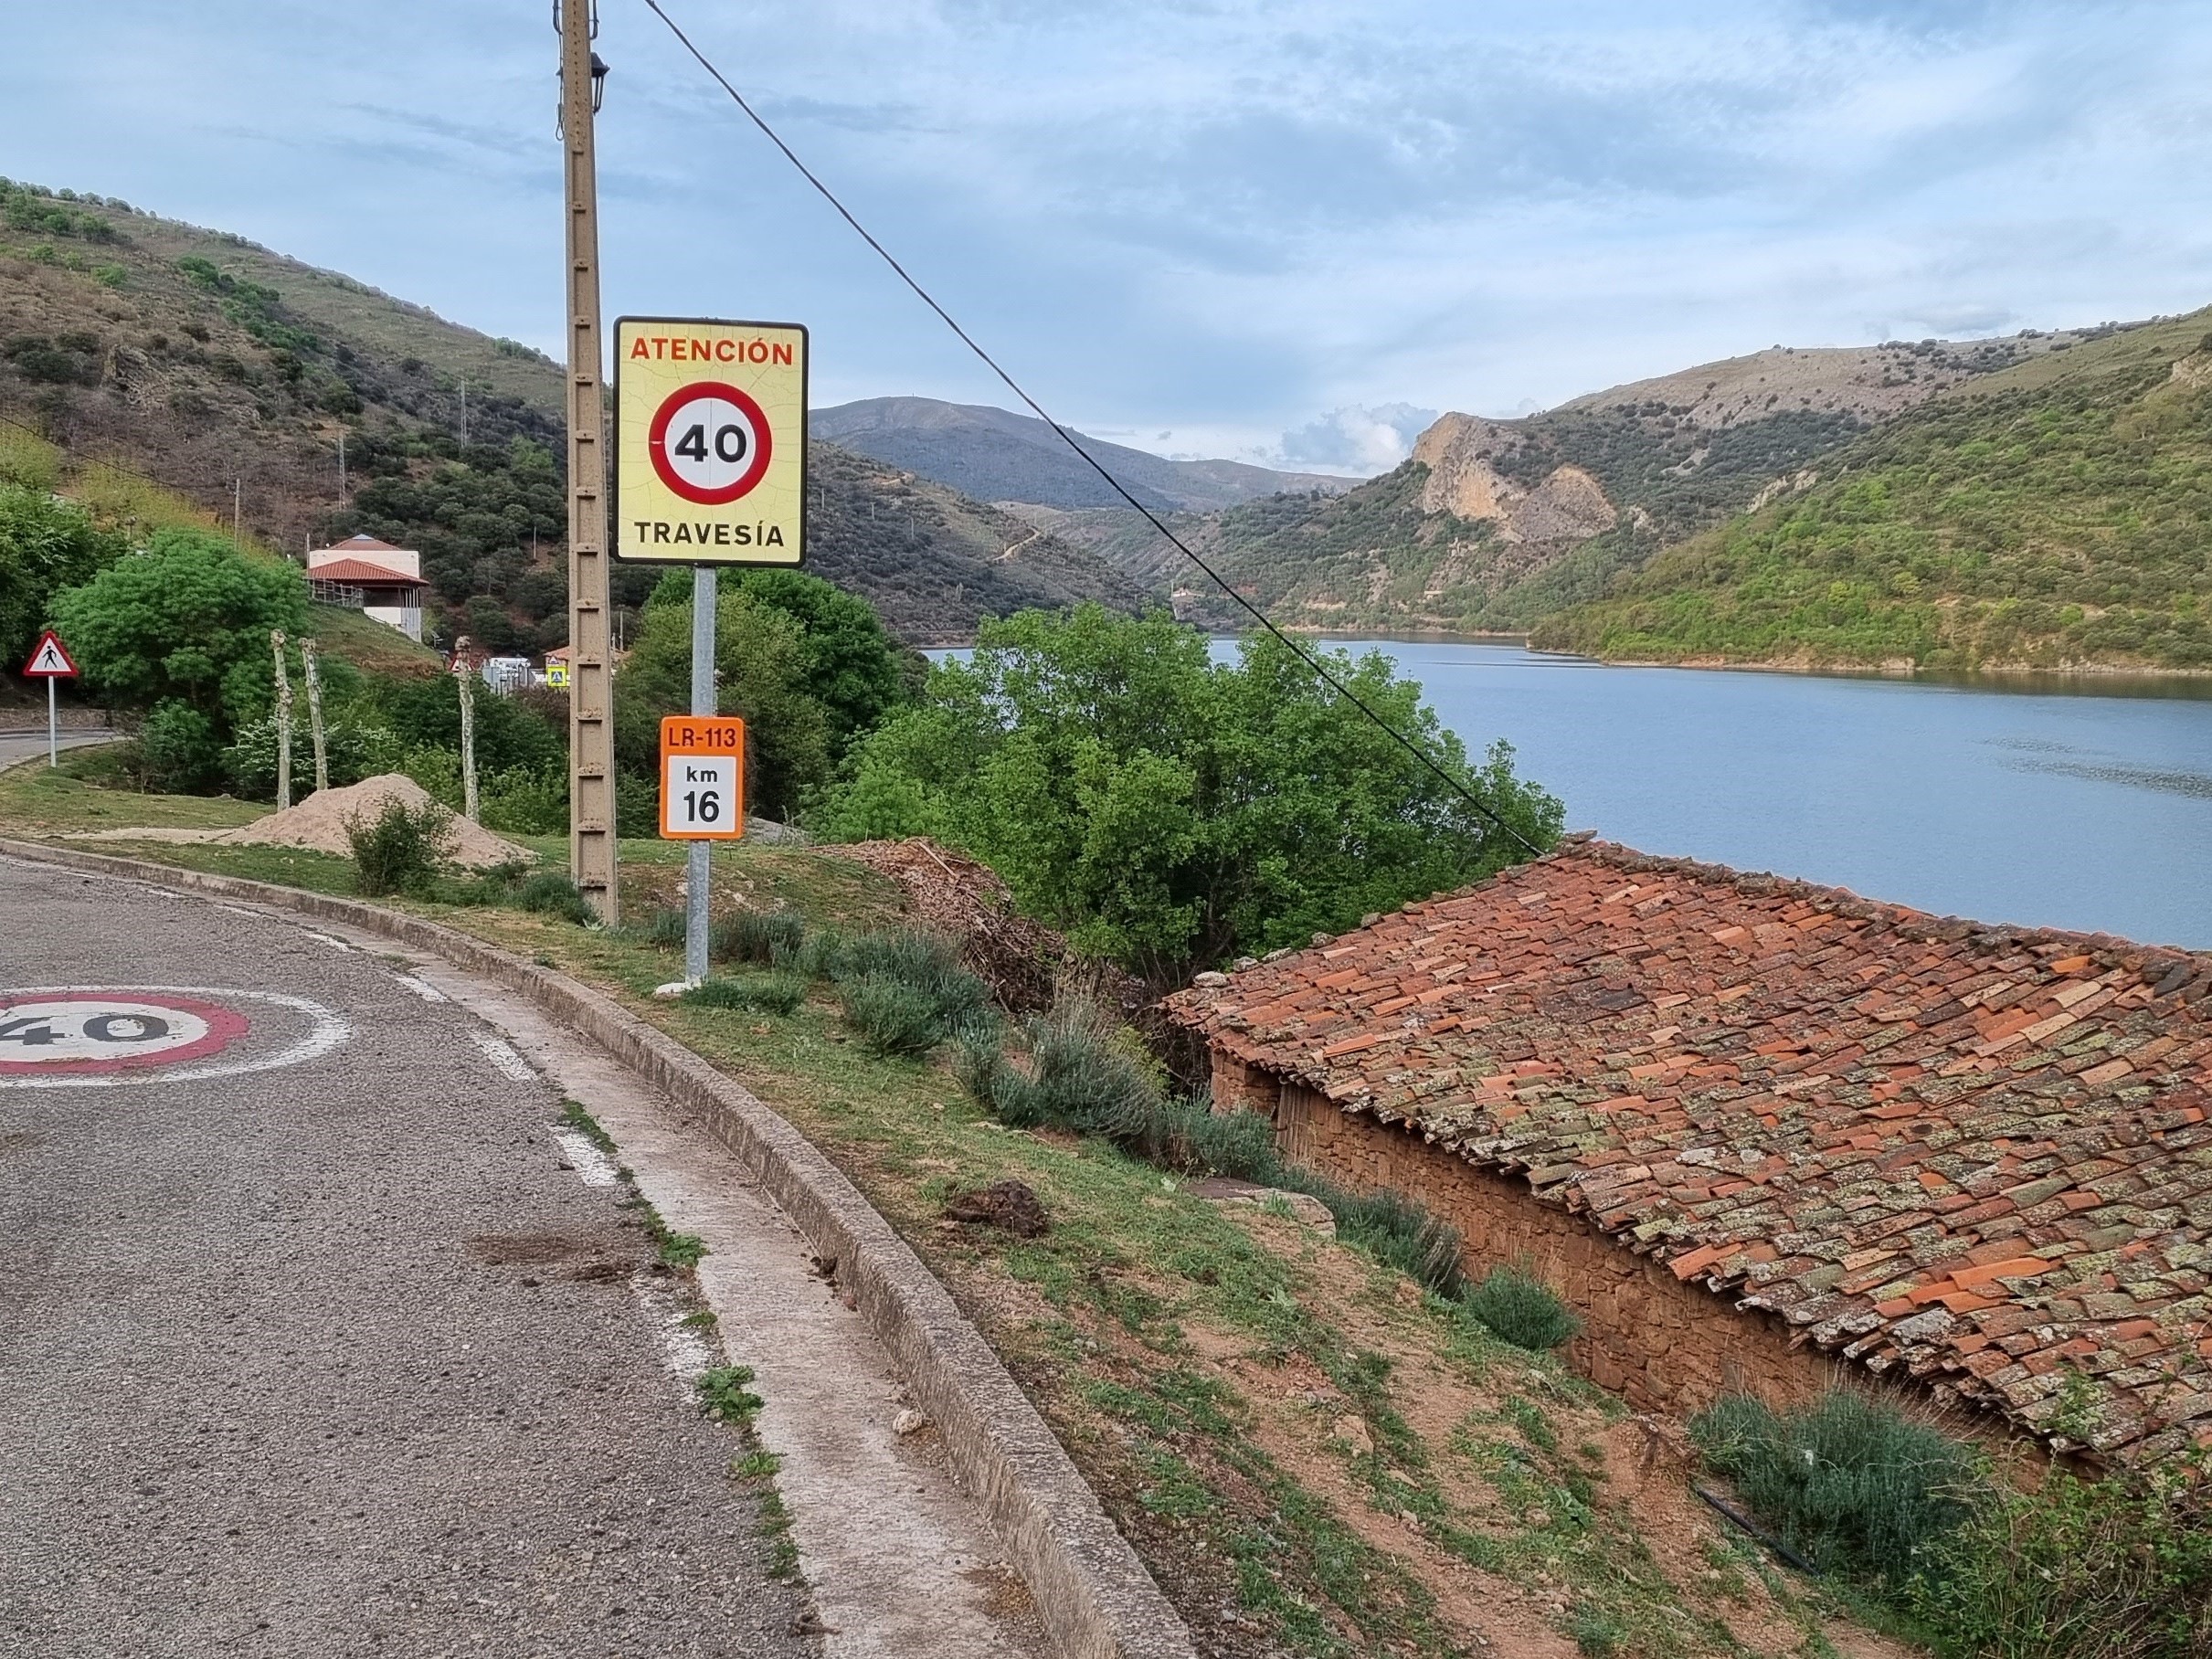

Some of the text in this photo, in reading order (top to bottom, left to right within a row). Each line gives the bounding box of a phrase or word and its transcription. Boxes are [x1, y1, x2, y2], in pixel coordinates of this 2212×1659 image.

[630, 337, 792, 365] ATENCIÓN
[674, 424, 747, 463] 40
[634, 520, 784, 547] TRAVESÍA
[669, 727, 736, 747] LR-113
[686, 766, 718, 783] km
[683, 790, 720, 822] 16
[0, 1013, 170, 1045] 40
